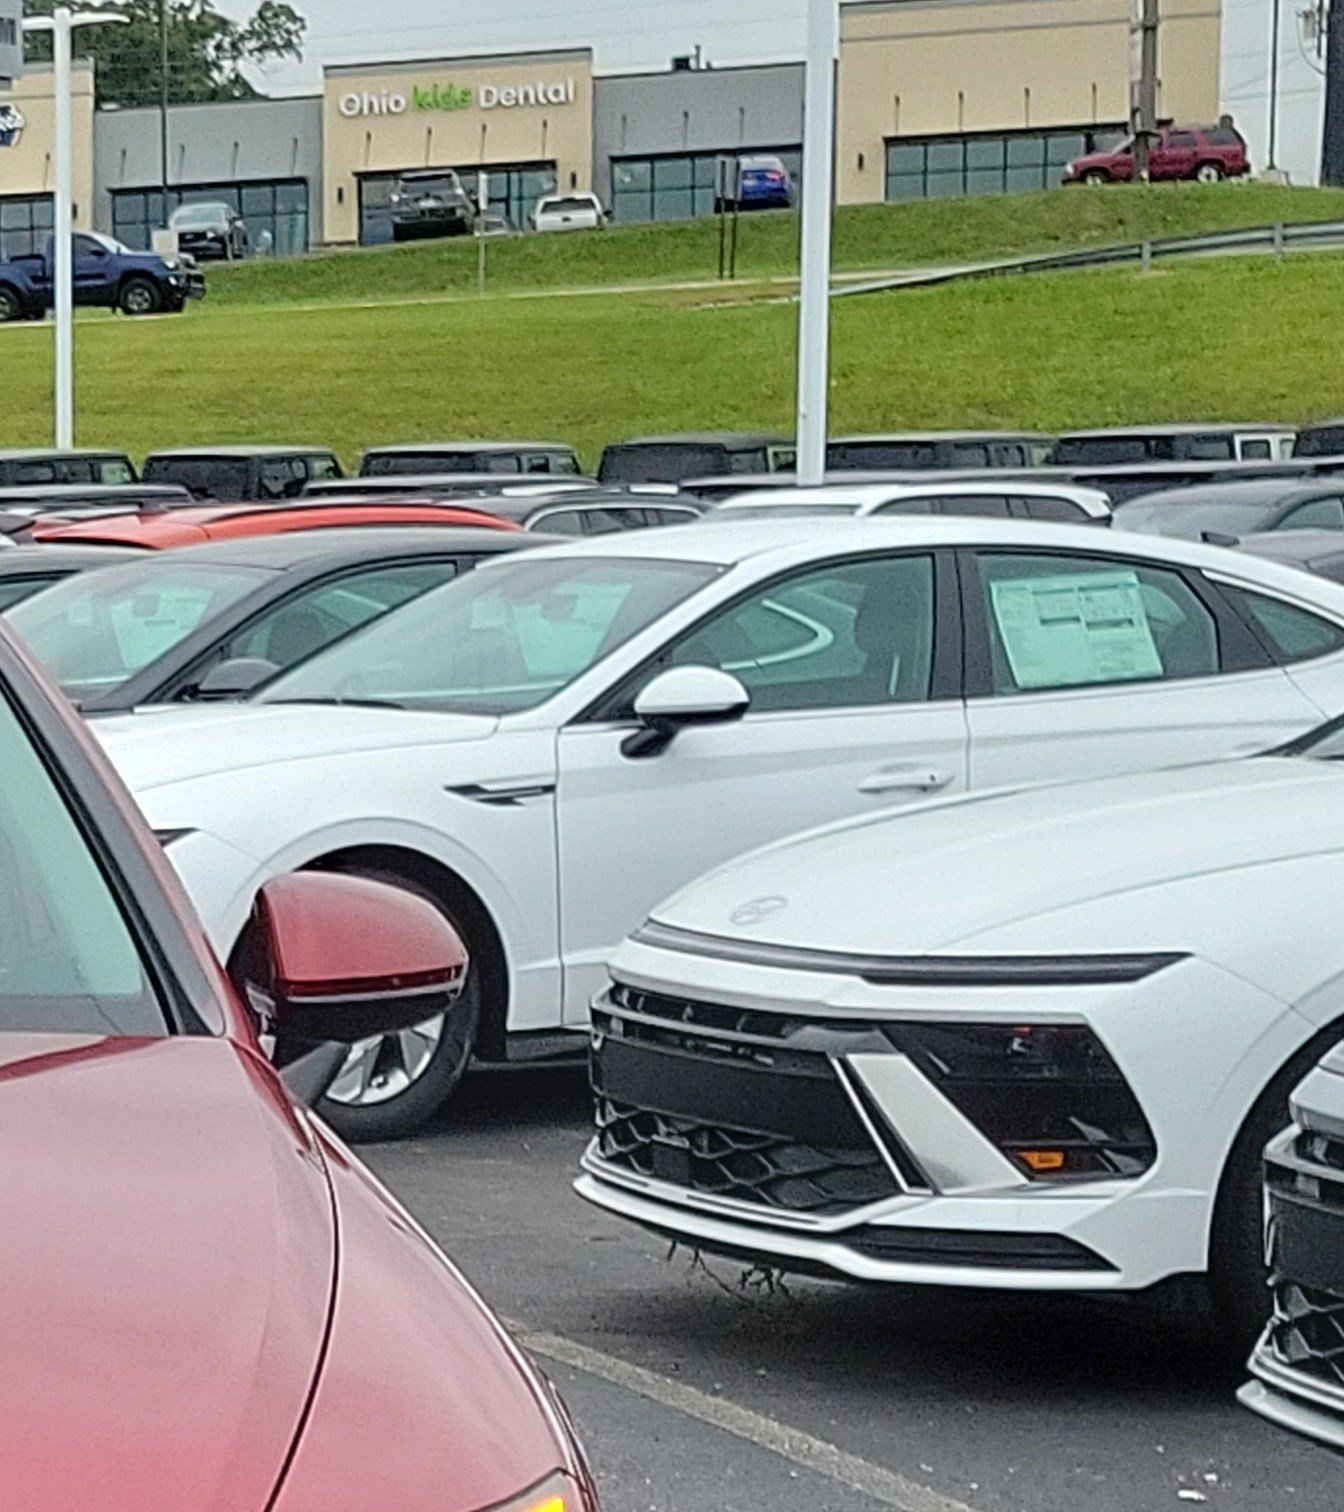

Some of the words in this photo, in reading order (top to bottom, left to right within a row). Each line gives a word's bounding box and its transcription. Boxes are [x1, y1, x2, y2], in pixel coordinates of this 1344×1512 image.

[338, 88, 407, 117] Ohio
[413, 82, 472, 110] kids
[478, 77, 575, 109] Dental
